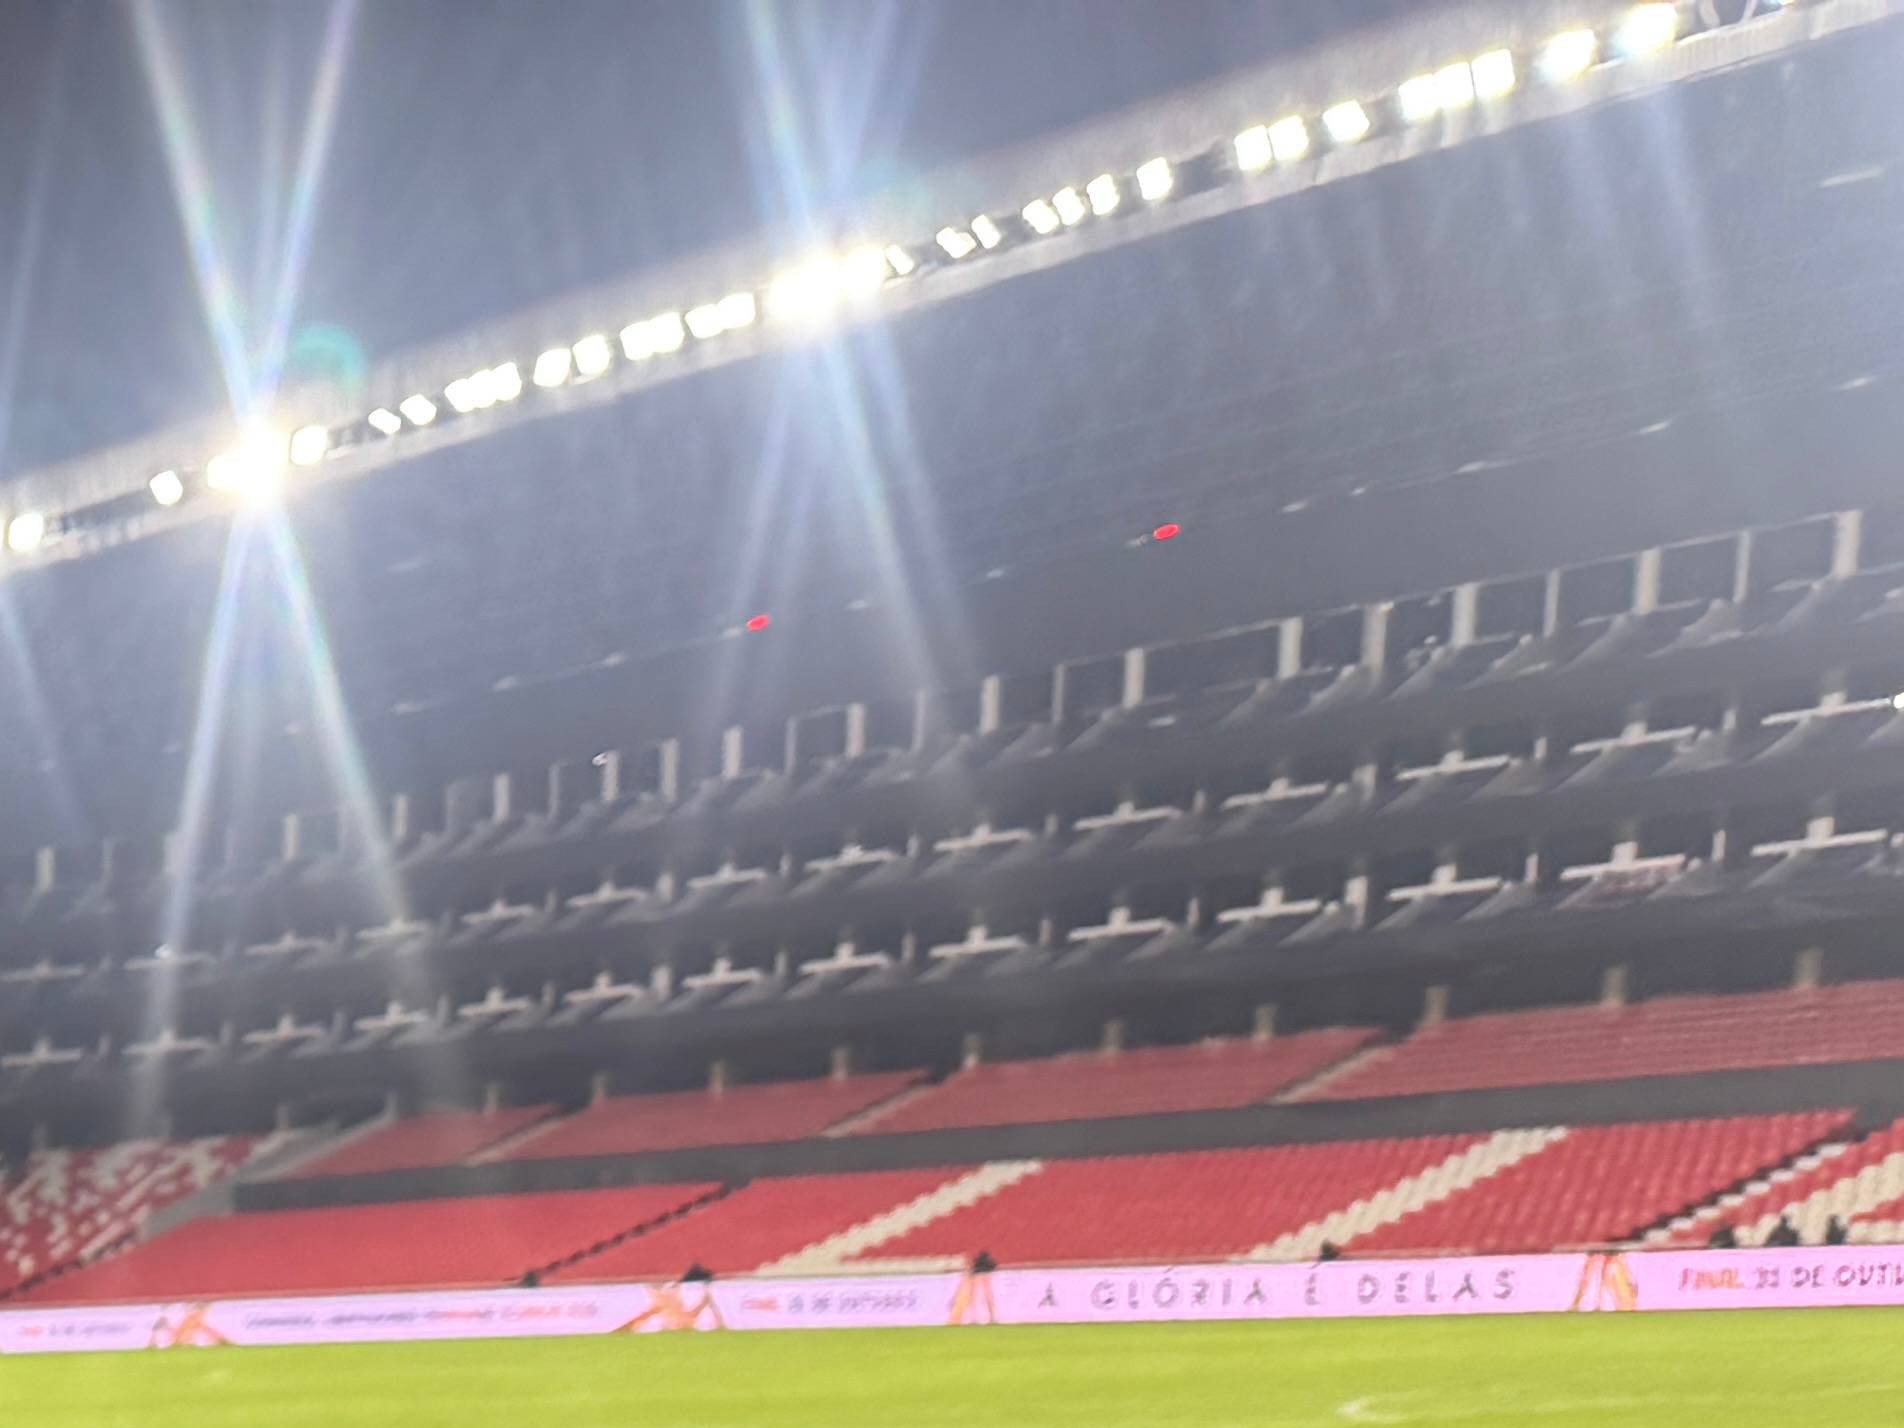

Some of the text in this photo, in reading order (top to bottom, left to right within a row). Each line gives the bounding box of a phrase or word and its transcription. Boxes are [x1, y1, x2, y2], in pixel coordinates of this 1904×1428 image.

[1038, 1282, 1059, 1309] A
[1089, 1266, 1268, 1311] GLÓRIA
[1357, 1268, 1515, 1305] DELAS
